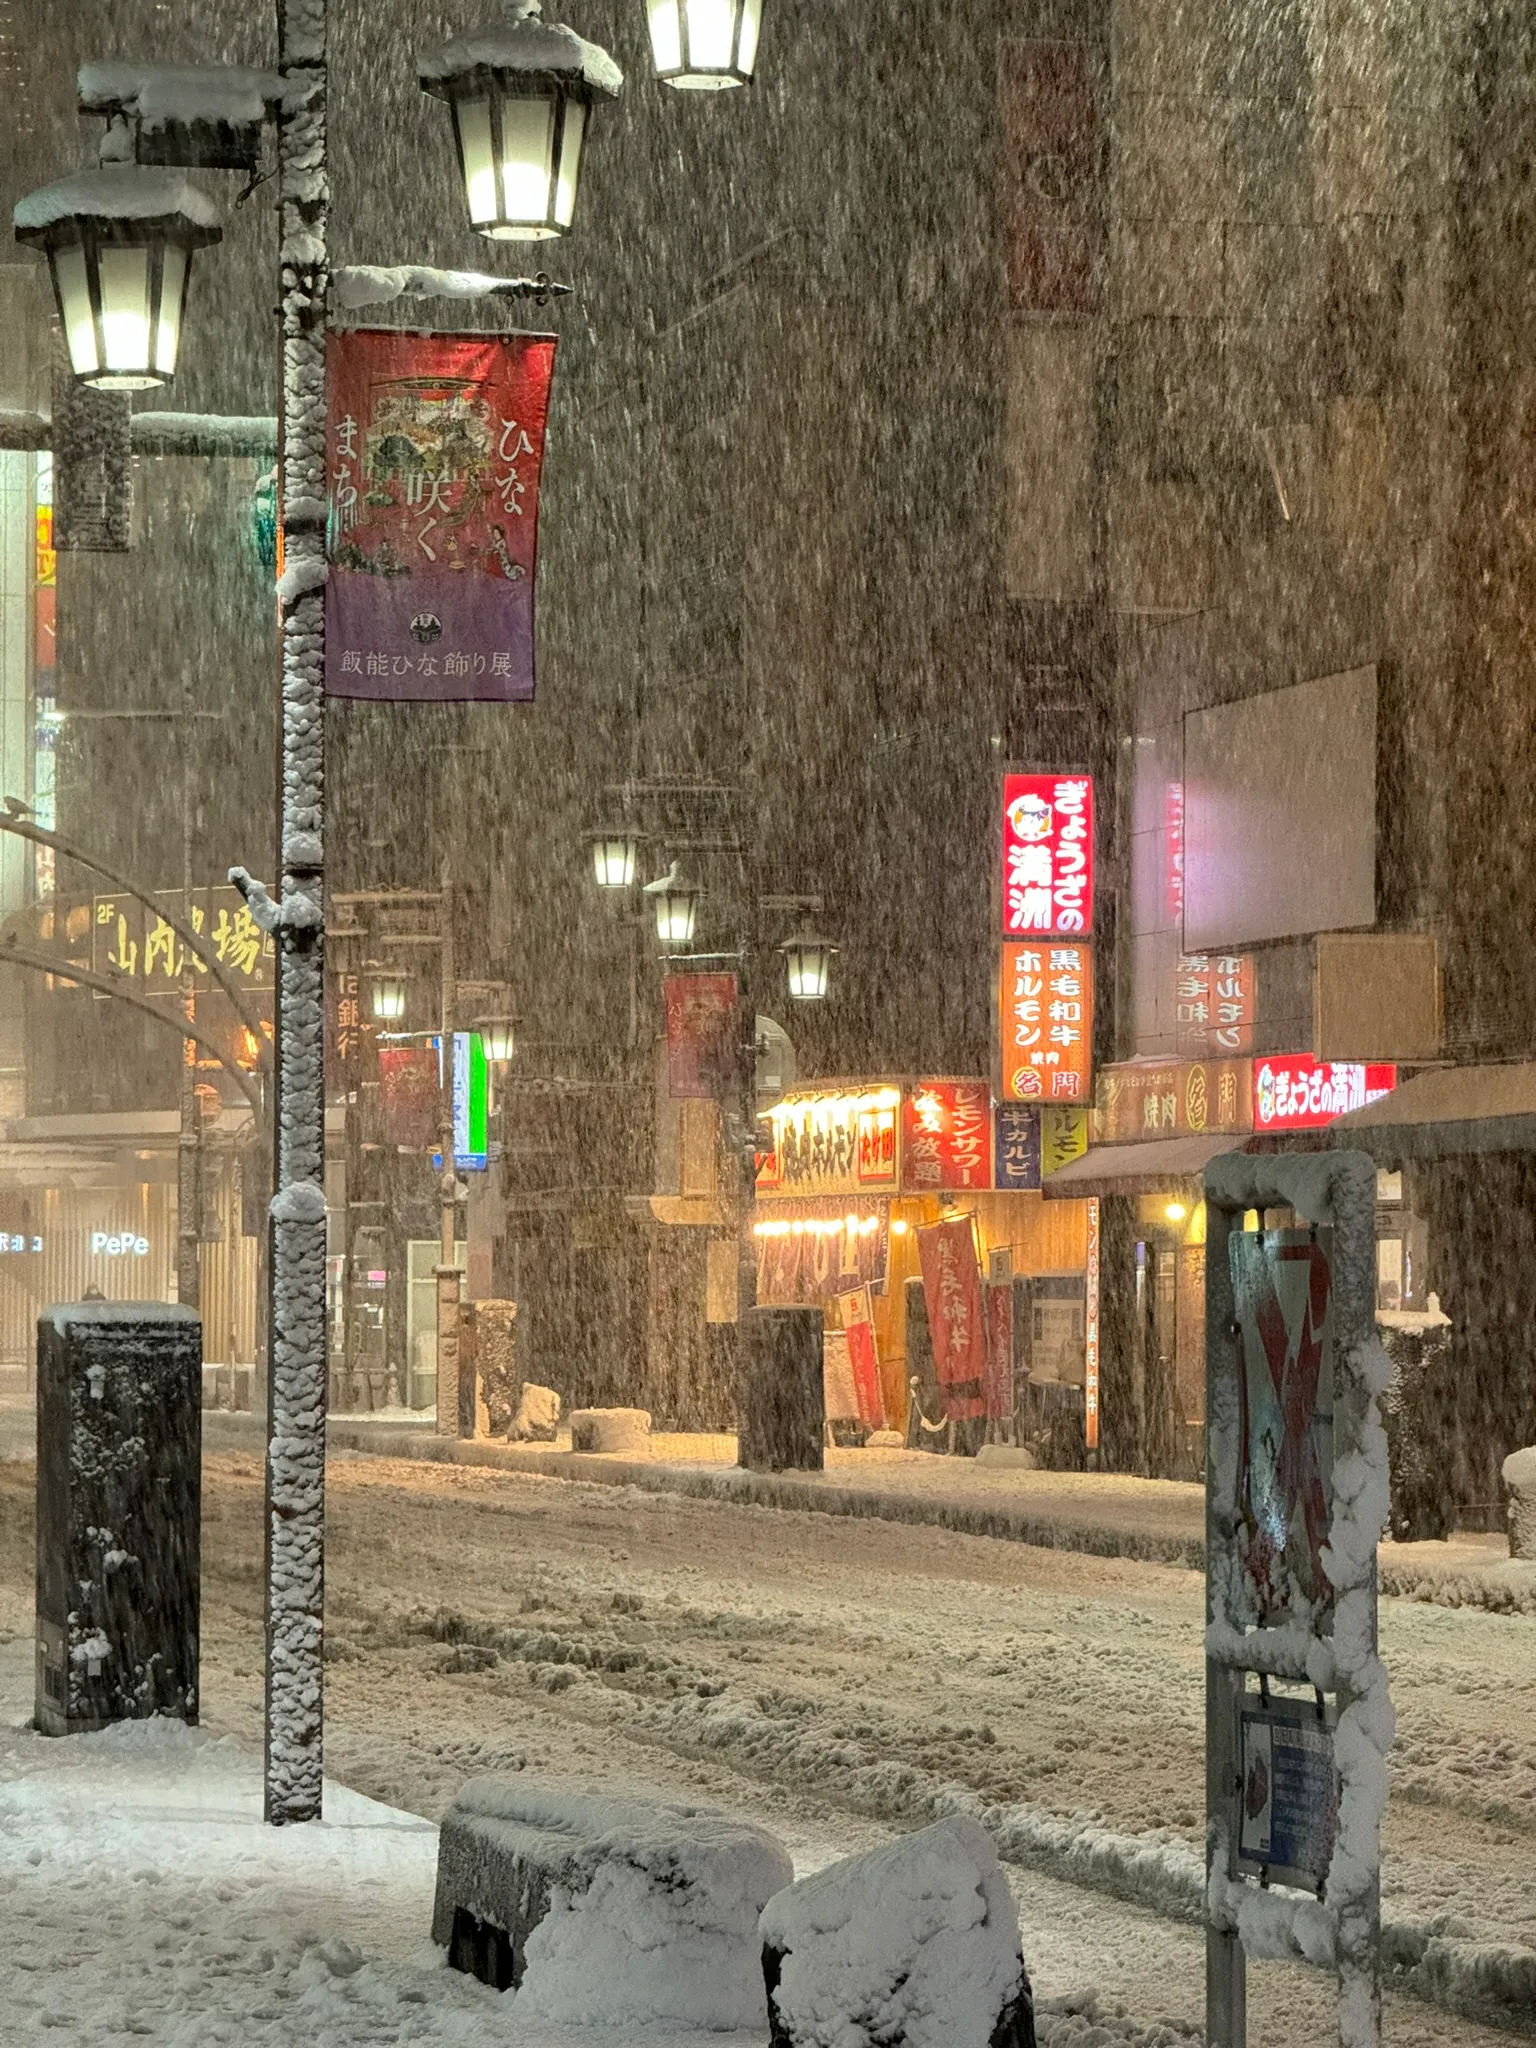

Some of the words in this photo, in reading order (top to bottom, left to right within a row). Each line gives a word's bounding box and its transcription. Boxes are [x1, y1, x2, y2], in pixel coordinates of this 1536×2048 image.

[333, 413, 359, 510] まち
[496, 418, 534, 516] ひな
[406, 471, 452, 562] 咲く
[340, 649, 513, 678] 飯能ひな飾り展
[1053, 780, 1088, 931] ぎょうざの
[97, 903, 115, 924] 2F
[1013, 949, 1043, 1046] ホルモン
[1049, 949, 1082, 1047] 黒毛和牛
[1015, 1071, 1080, 1098] 名門
[1030, 1051, 1060, 1065] 焼肉
[950, 1087, 984, 1185] レモンサワー
[92, 1232, 149, 1255] PePe
